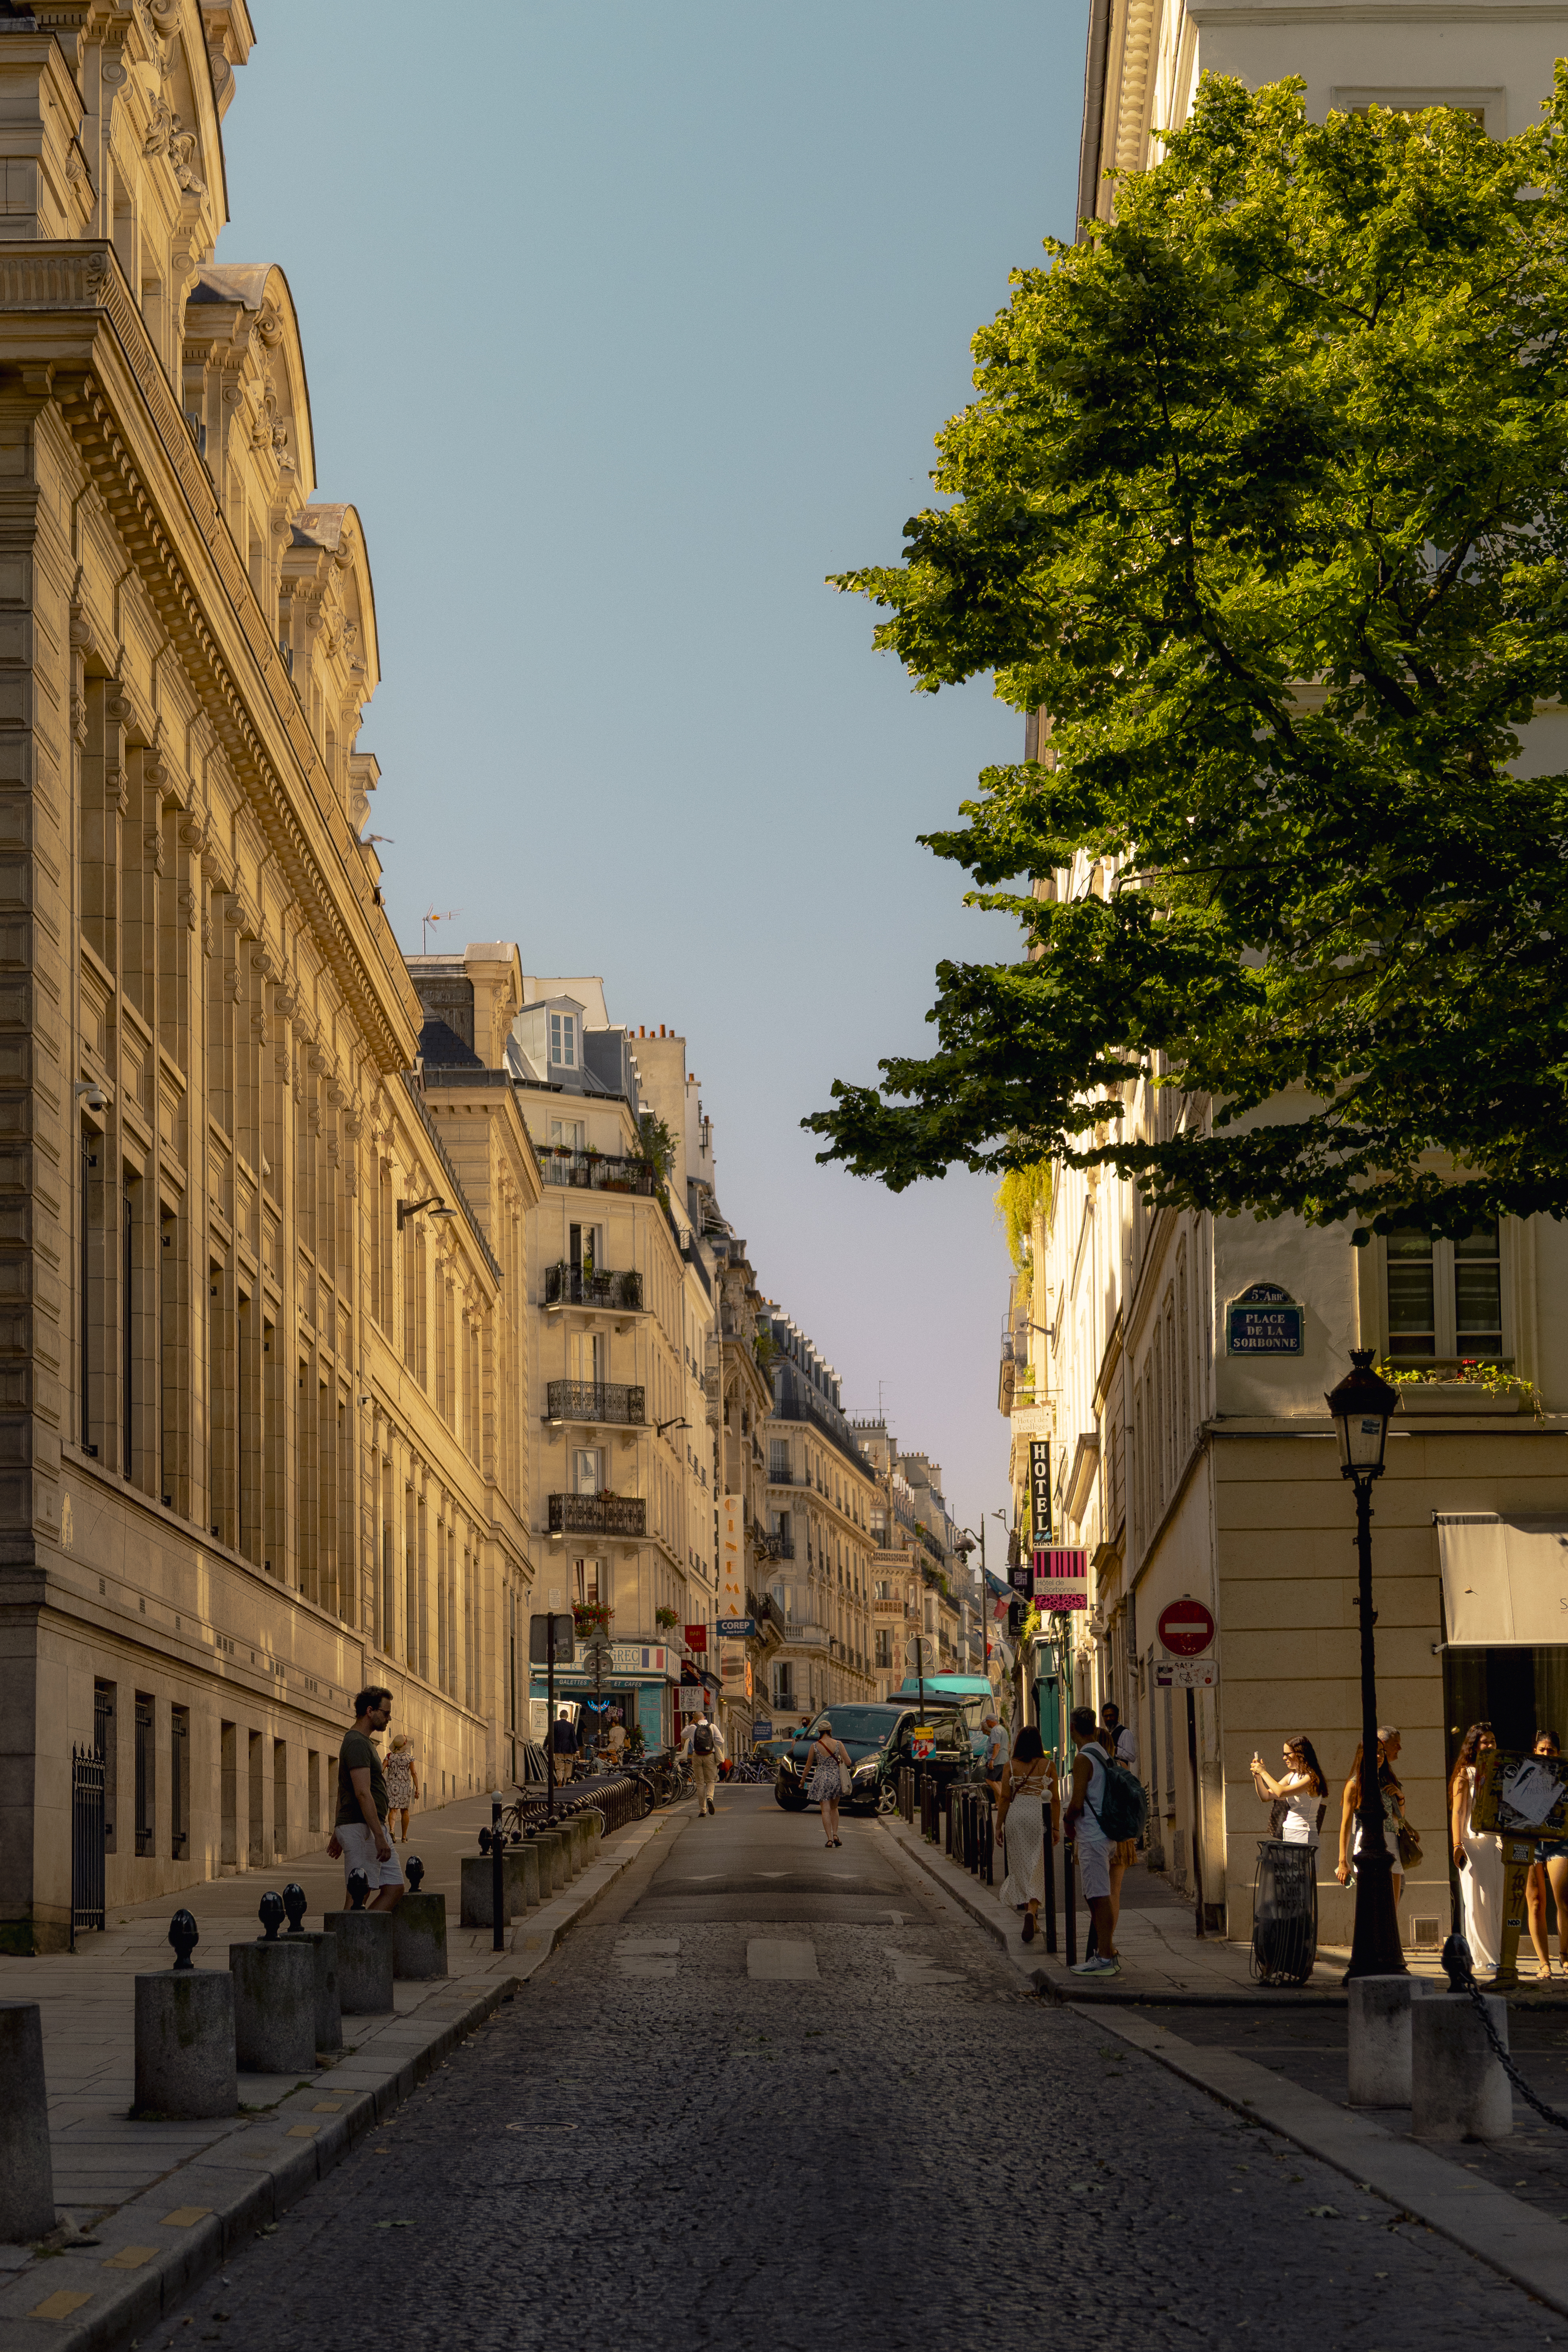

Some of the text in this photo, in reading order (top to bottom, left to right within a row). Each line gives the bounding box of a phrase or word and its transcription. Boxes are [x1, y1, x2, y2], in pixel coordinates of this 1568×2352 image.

[1246, 1314, 1285, 1323] PLACE
[1247, 1326, 1283, 1335] DE LA
[1233, 1338, 1297, 1347] SORBONNE
[1022, 1423, 1048, 1431] collèges
[1033, 1444, 1048, 1531] HOTEL
[723, 1498, 740, 1615] CINEMA
[609, 1648, 638, 1661] GREC
